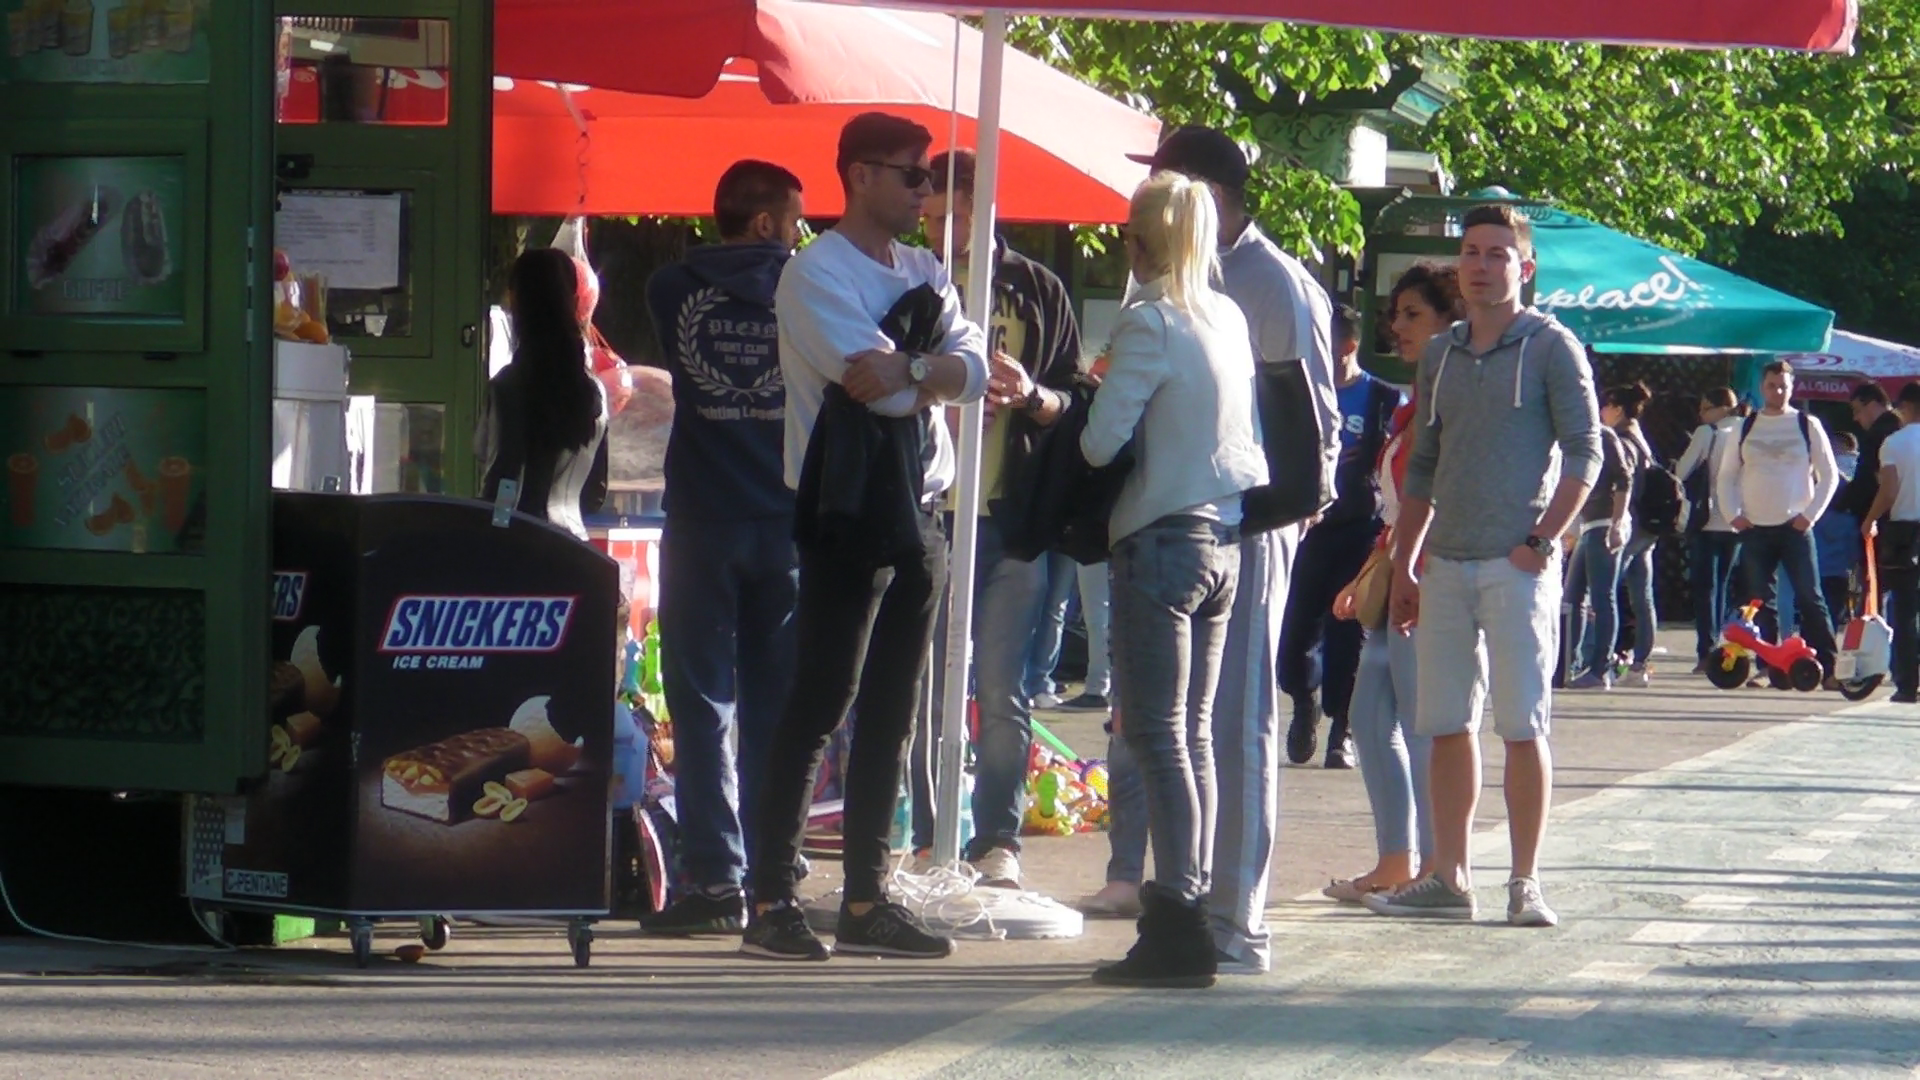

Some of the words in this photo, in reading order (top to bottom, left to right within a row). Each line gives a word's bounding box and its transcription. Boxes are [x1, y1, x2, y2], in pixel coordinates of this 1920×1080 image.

[1796, 381, 1851, 393] ALGIDA
[393, 600, 568, 647] SNICKERS
[393, 656, 420, 669] ICE
[426, 656, 483, 669] CREAM
